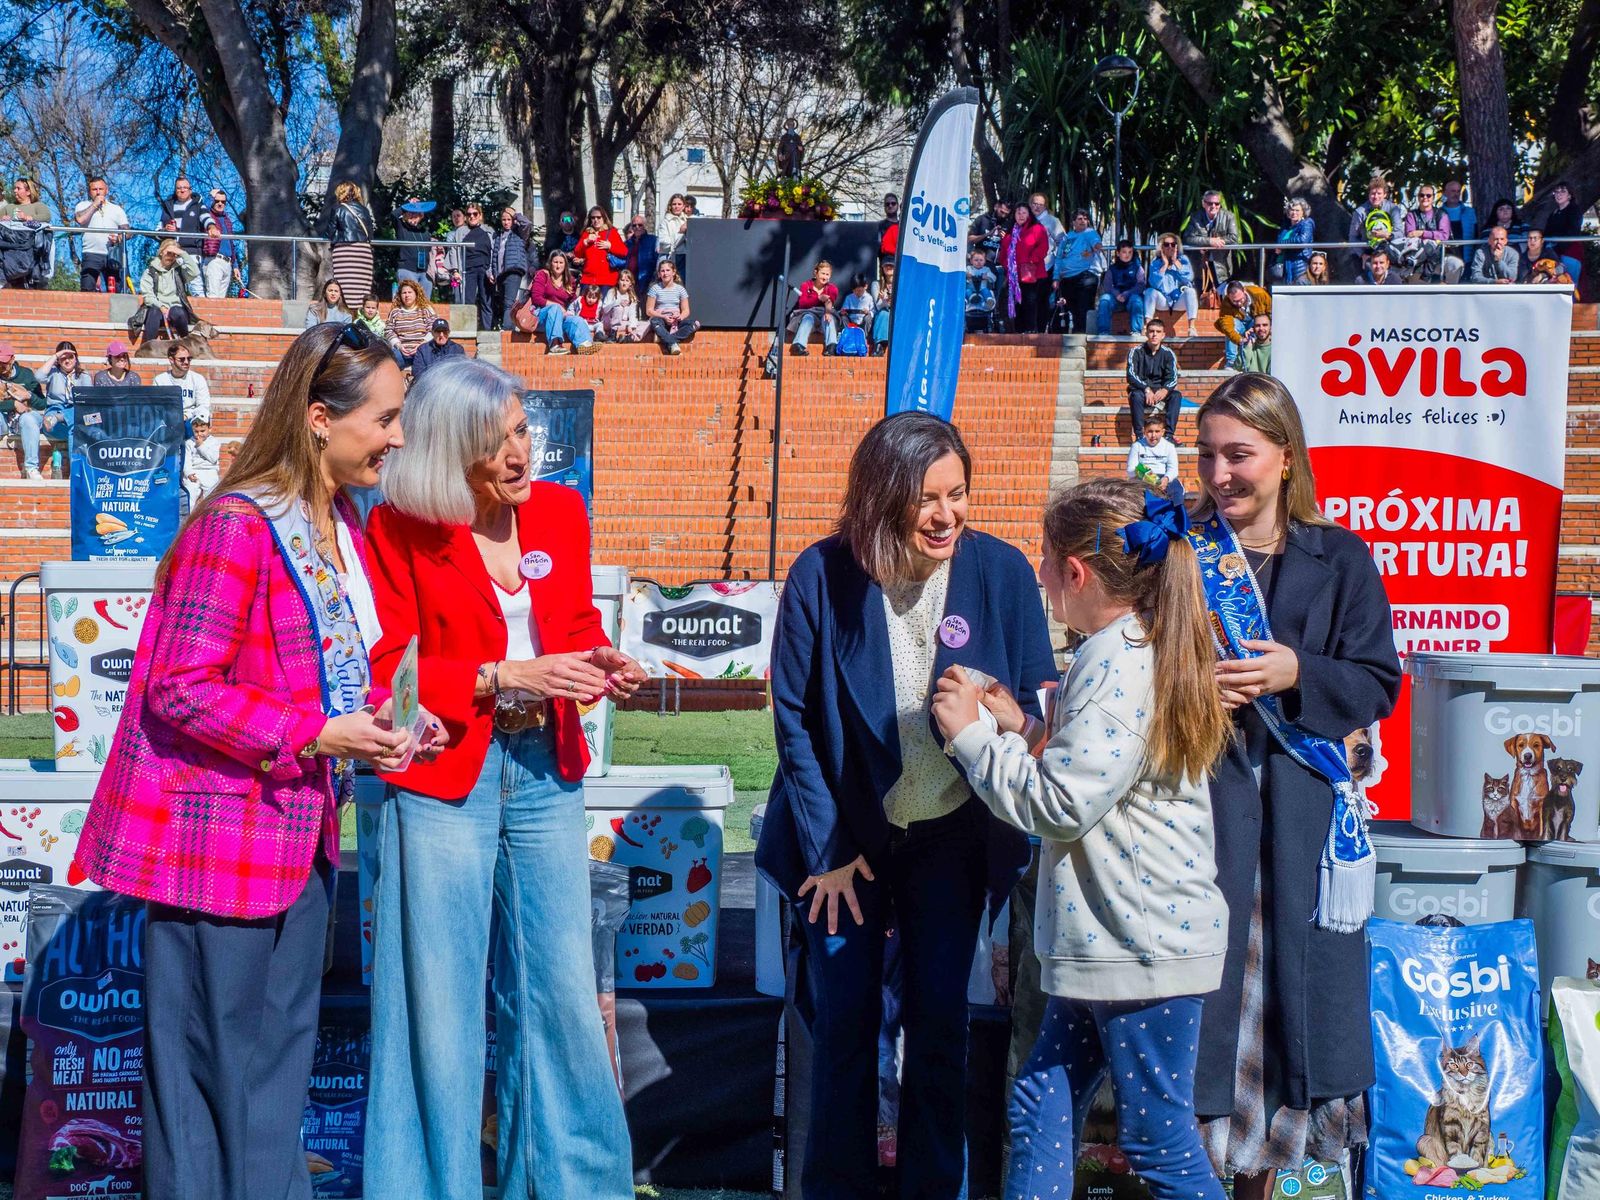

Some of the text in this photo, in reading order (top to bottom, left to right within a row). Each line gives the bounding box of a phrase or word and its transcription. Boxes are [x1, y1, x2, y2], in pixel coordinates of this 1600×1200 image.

[1370, 327, 1480, 342] MASCOTAS
[1338, 406, 1479, 425] Animales felices
[99, 445, 153, 460] ownat
[534, 448, 563, 462] nat
[97, 483, 114, 491] FRESH
[117, 477, 133, 491] NO
[96, 490, 112, 498] MEAT
[102, 501, 140, 512] NATURAL
[1324, 487, 1522, 532] PRÓXIMA
[1367, 539, 1529, 578] RTURA!
[661, 614, 743, 635] ownat
[1392, 609, 1501, 631] RNANDO
[688, 639, 707, 647] REAL
[101, 658, 135, 670] own
[105, 690, 125, 702] NAT
[1483, 706, 1583, 737] Gosbi
[637, 875, 662, 887] nat
[0, 900, 28, 912] NATUR
[1388, 887, 1489, 918] Gosbi
[3, 915, 19, 923] REAL
[650, 912, 680, 921] NATURAL
[629, 923, 674, 936] VERDAD
[1402, 954, 1511, 999] Gosbi
[59, 988, 142, 1013] owna
[1418, 999, 1499, 1022] Exclusive
[54, 1041, 78, 1059] only
[53, 1057, 85, 1070] FRESH
[92, 1046, 121, 1071] NO
[53, 1070, 84, 1085] MEAT
[65, 1090, 137, 1111] NATURAL
[325, 1111, 342, 1127] NO
[306, 1138, 350, 1150] NATURAL
[70, 1181, 132, 1192] DOG FOOD
[1087, 1186, 1114, 1194] Lamb
